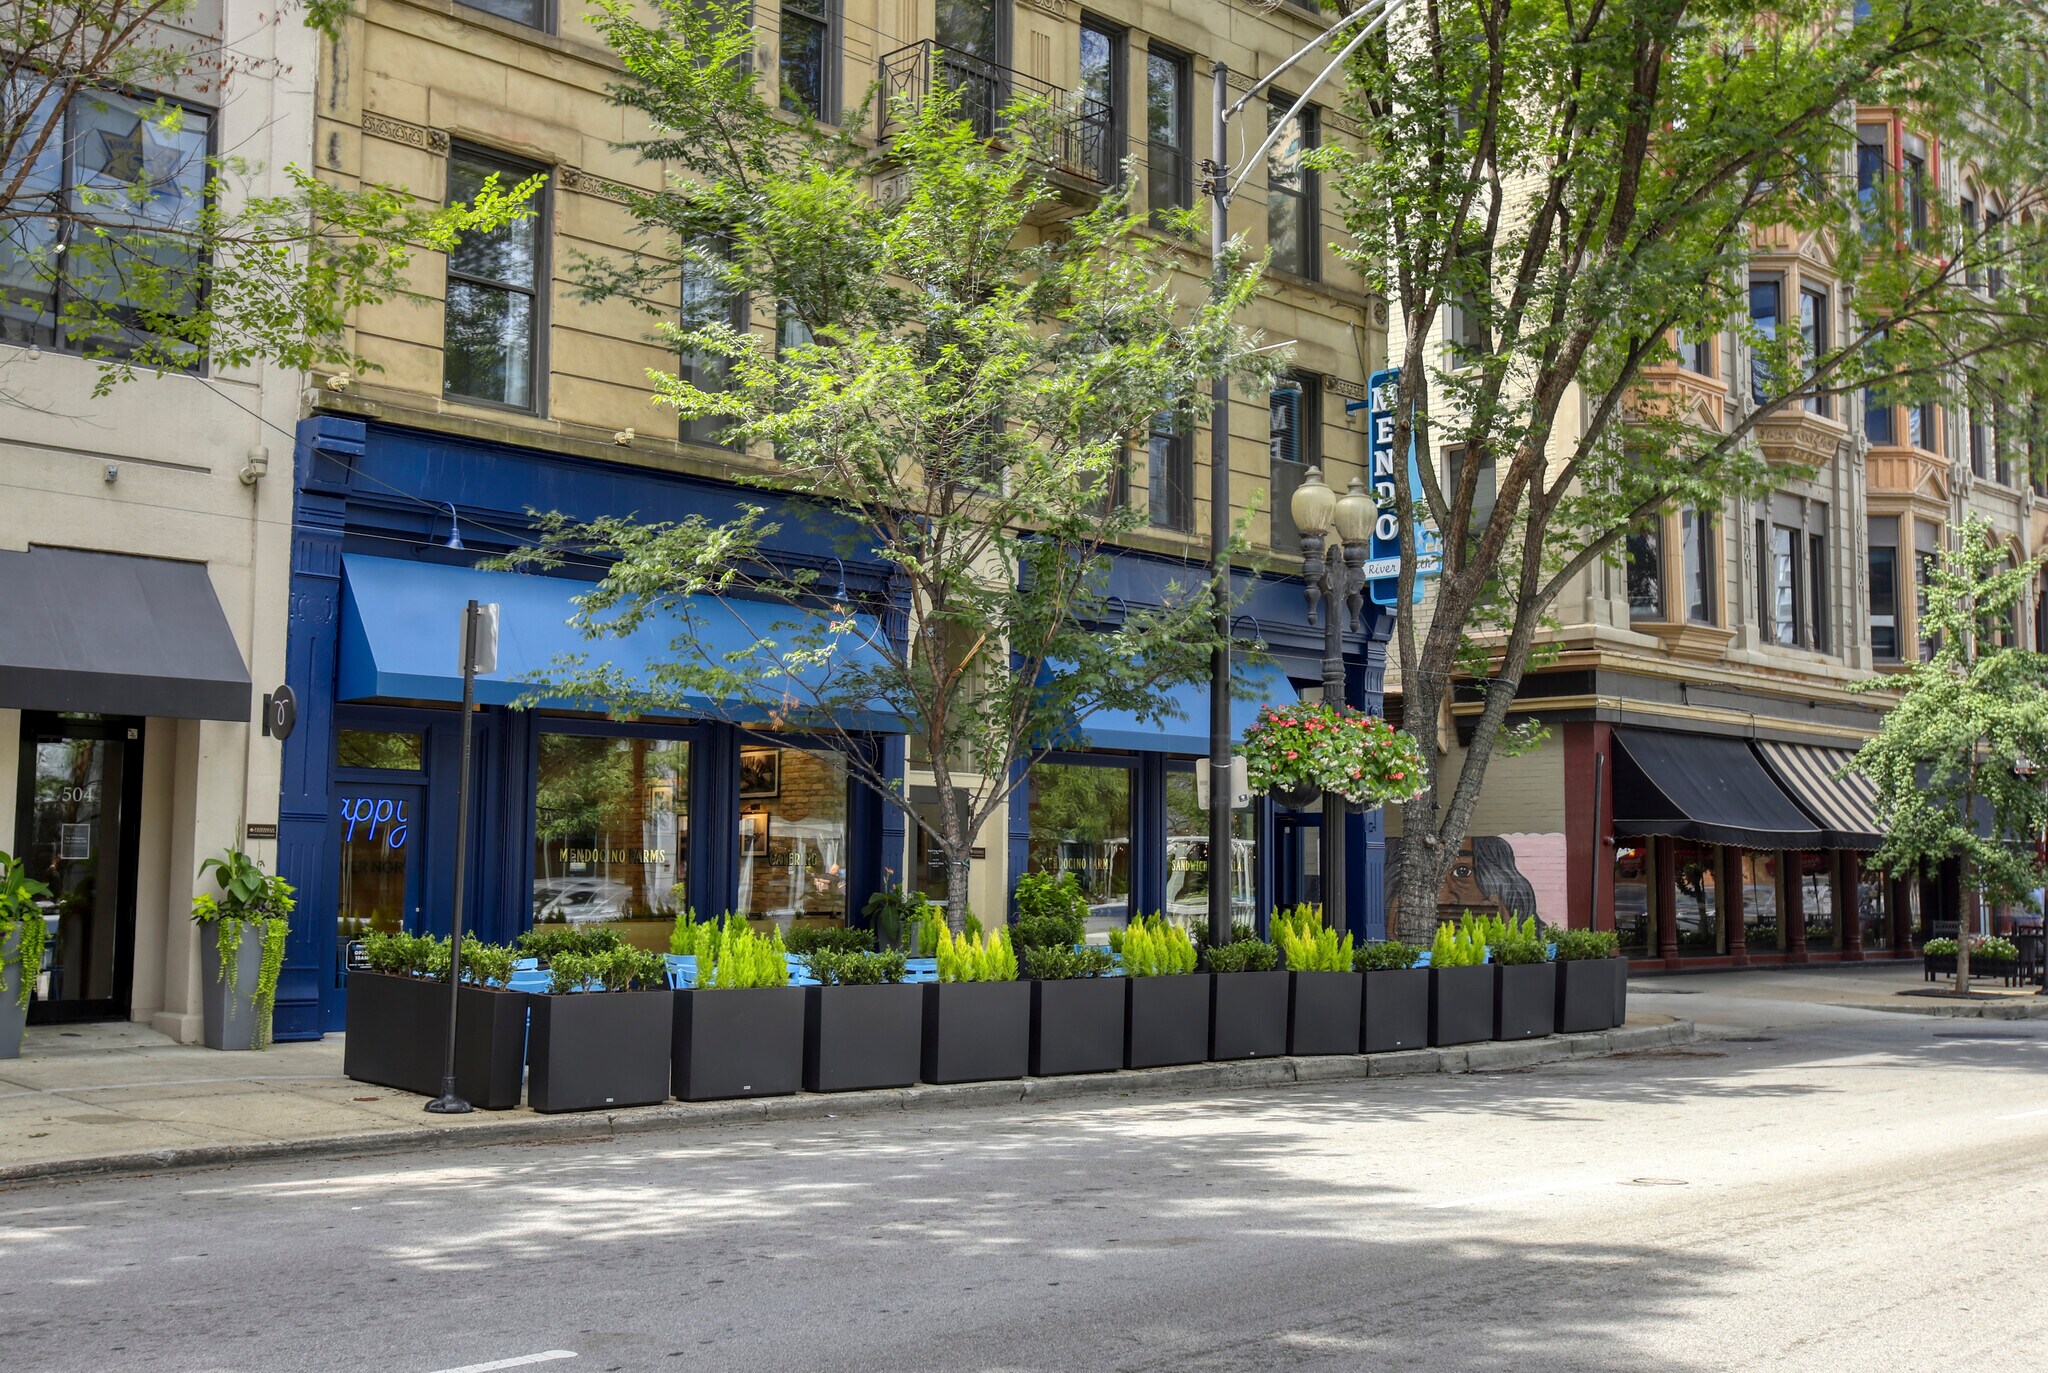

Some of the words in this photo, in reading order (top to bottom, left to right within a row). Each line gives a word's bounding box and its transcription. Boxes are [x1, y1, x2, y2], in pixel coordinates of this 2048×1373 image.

[1371, 383, 1400, 541] MENDO
[1368, 563, 1398, 575] River
[62, 786, 94, 802] 504
[559, 848, 626, 863] MENDOCINO
[629, 848, 666, 864] FARMS
[769, 852, 818, 867] CATERING
[1088, 858, 1112, 870] FARM
